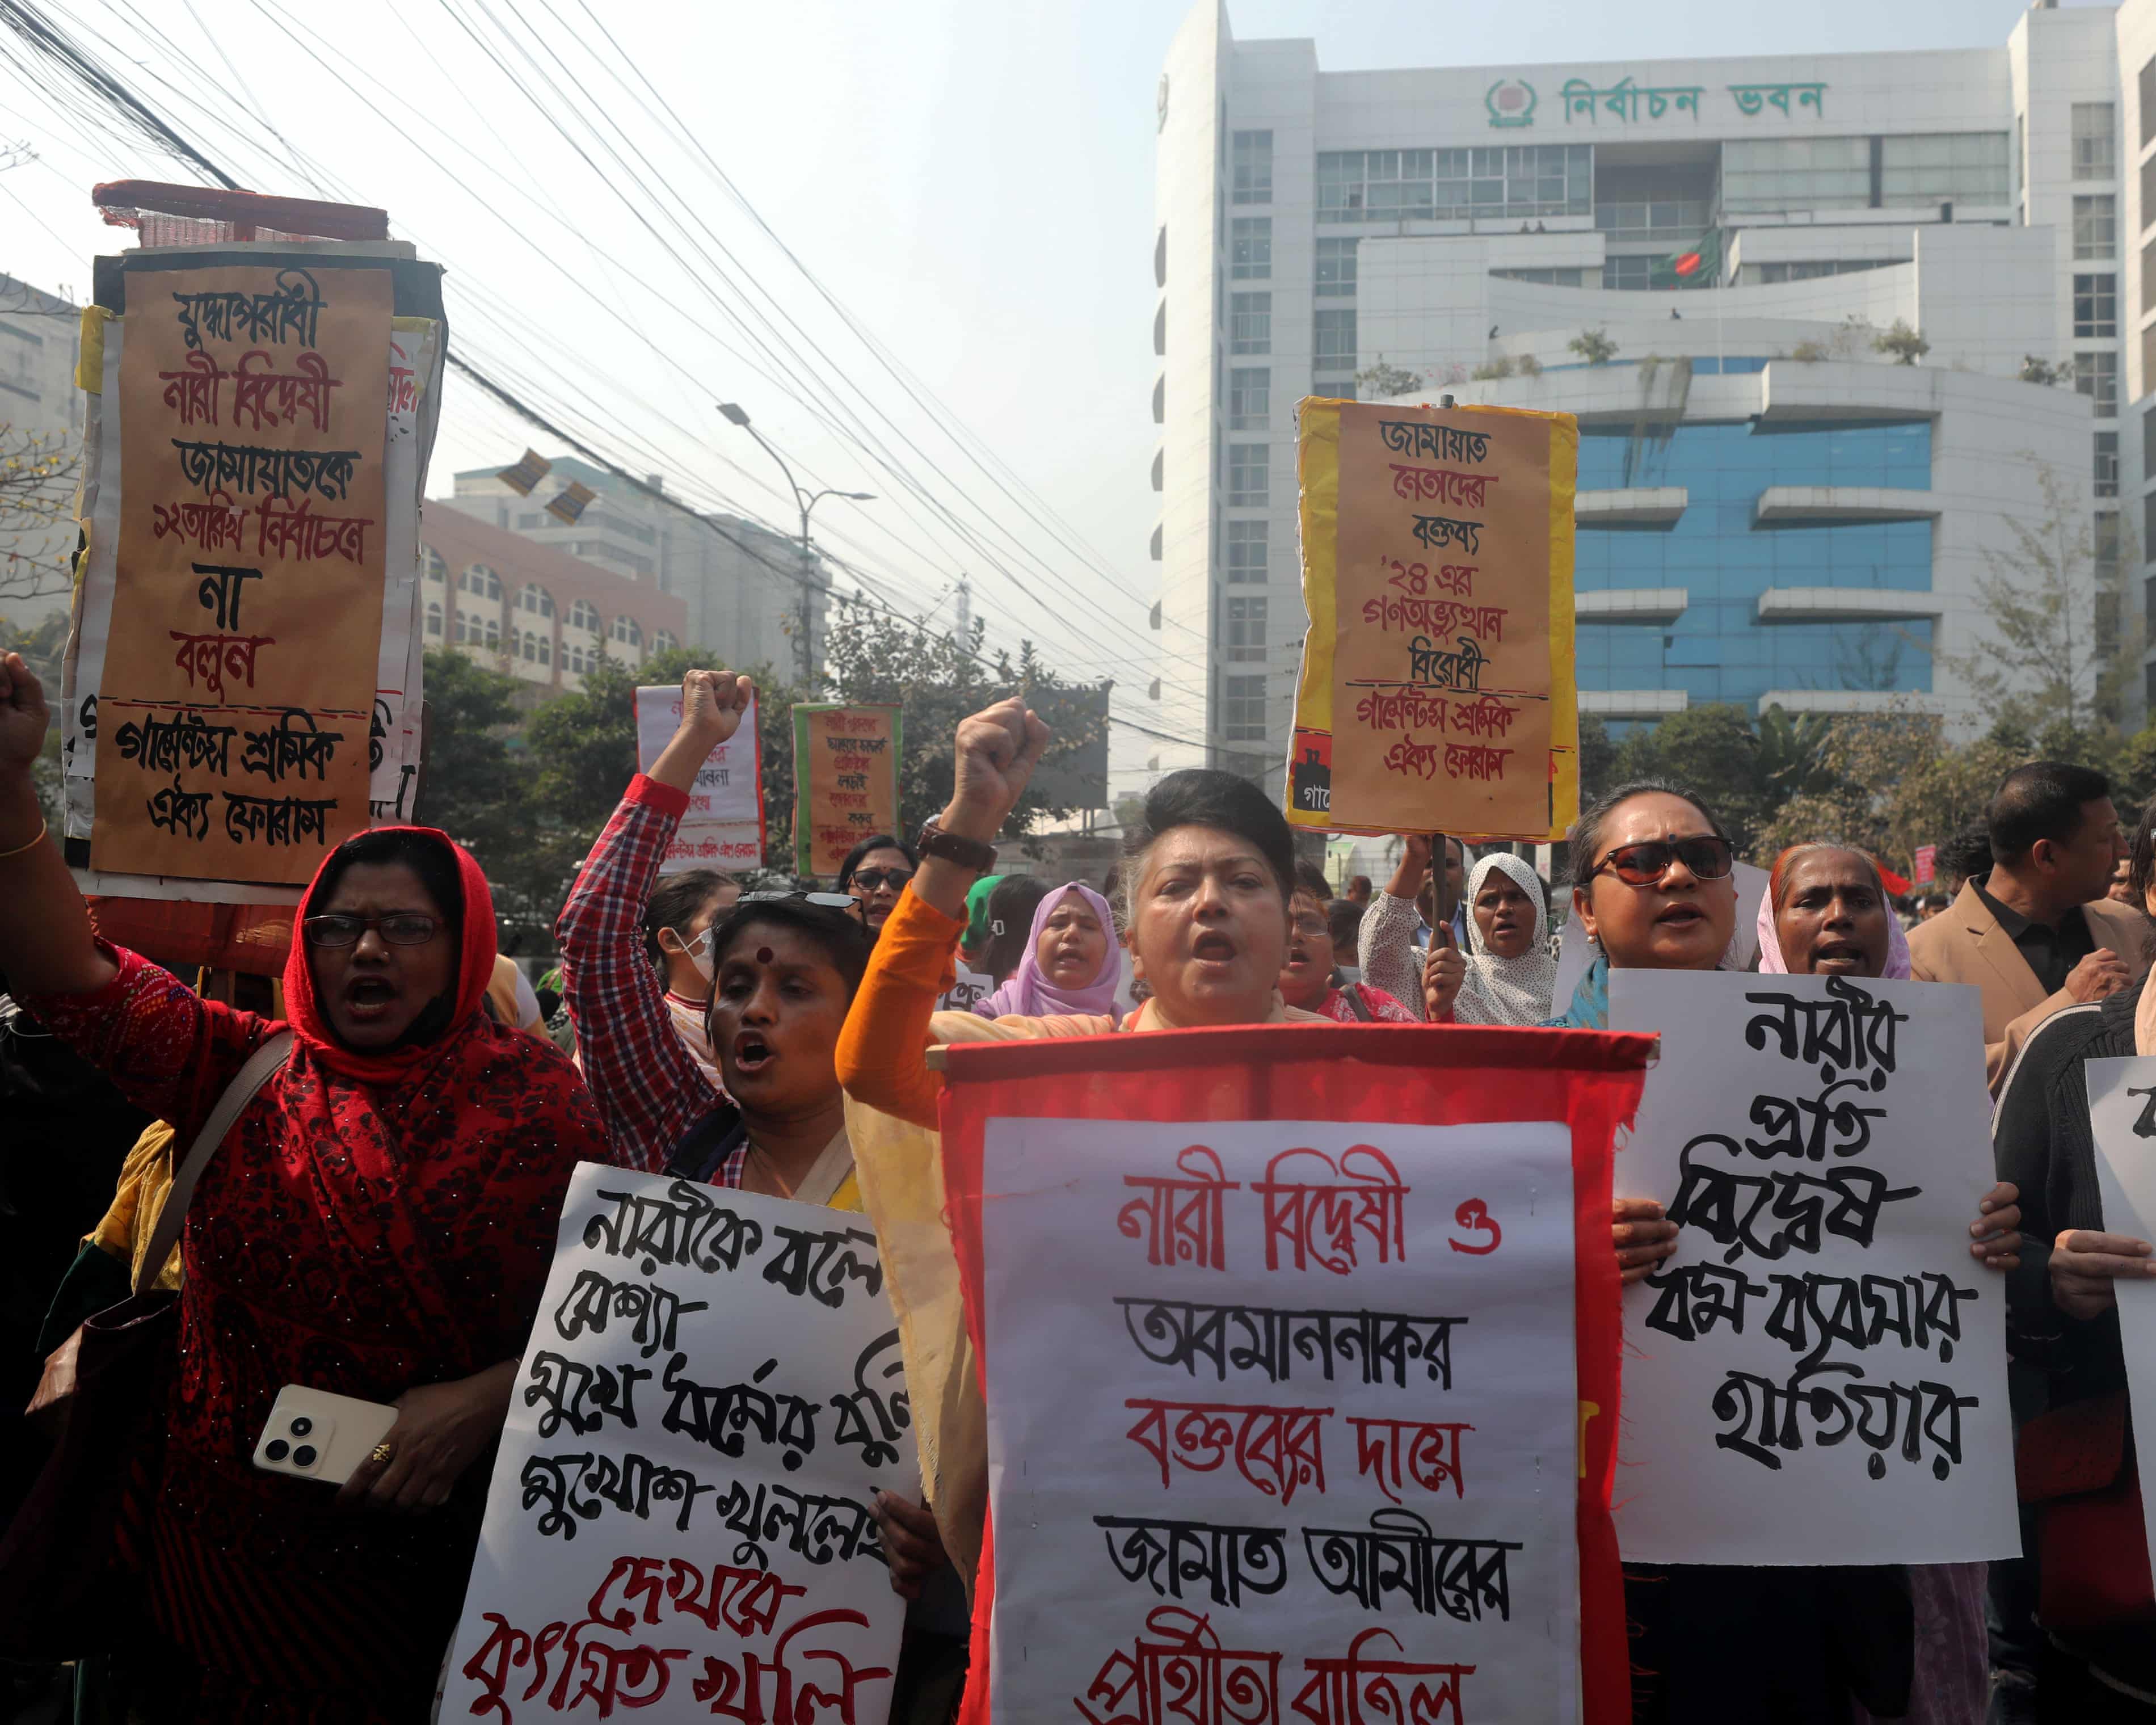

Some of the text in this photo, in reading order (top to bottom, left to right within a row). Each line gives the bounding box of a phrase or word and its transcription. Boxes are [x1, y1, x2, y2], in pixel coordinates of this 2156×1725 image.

[1559, 77, 1828, 125] নির্বাচন ভবন
[172, 268, 327, 354] যুদ্ধাপরাধী
[159, 350, 229, 427] নারী
[231, 350, 344, 432] বিদ্বেষী
[171, 438, 363, 500] জামায়াতকে
[1379, 420, 1492, 464] জামায়াত
[1388, 463, 1499, 508] নেতাদের
[255, 493, 374, 565] নির্বাচনে
[1412, 514, 1485, 556] বক্তব্য
[191, 562, 263, 630] না
[1434, 565, 1479, 597] এর
[170, 631, 276, 703] বলুন
[1408, 636, 1490, 690] বিরোধী
[241, 710, 344, 784] শ্রমিক
[1383, 733, 1515, 781] ঐক্য ফোরাম
[1450, 696, 1521, 738] শ্রমিক
[147, 774, 213, 841] ঐক্য
[224, 791, 338, 846] ফোরাম
[1745, 975, 1909, 1092] নারীর
[1745, 1079, 1887, 1162] প্রতি
[583, 1180, 763, 1276] নারীকে
[1117, 1143, 1502, 1276] নারী বিদ্বেষী ও
[1665, 1133, 1923, 1260] বিদ্বেষ
[555, 1269, 709, 1358] বেশ্যা
[1113, 1296, 1469, 1391] অবমাননাকর
[524, 1349, 653, 1440] মুখে
[662, 1353, 823, 1471] ধর্মের
[1712, 1361, 1979, 1482] হাতিয়ার
[520, 1451, 717, 1541] মুখোশ
[1346, 1416, 1476, 1505] দায়ে
[588, 1555, 807, 1638] দেখবে
[1093, 1508, 1523, 1623] জামাত আমীরের
[1291, 1627, 1477, 1725] বাতিল
